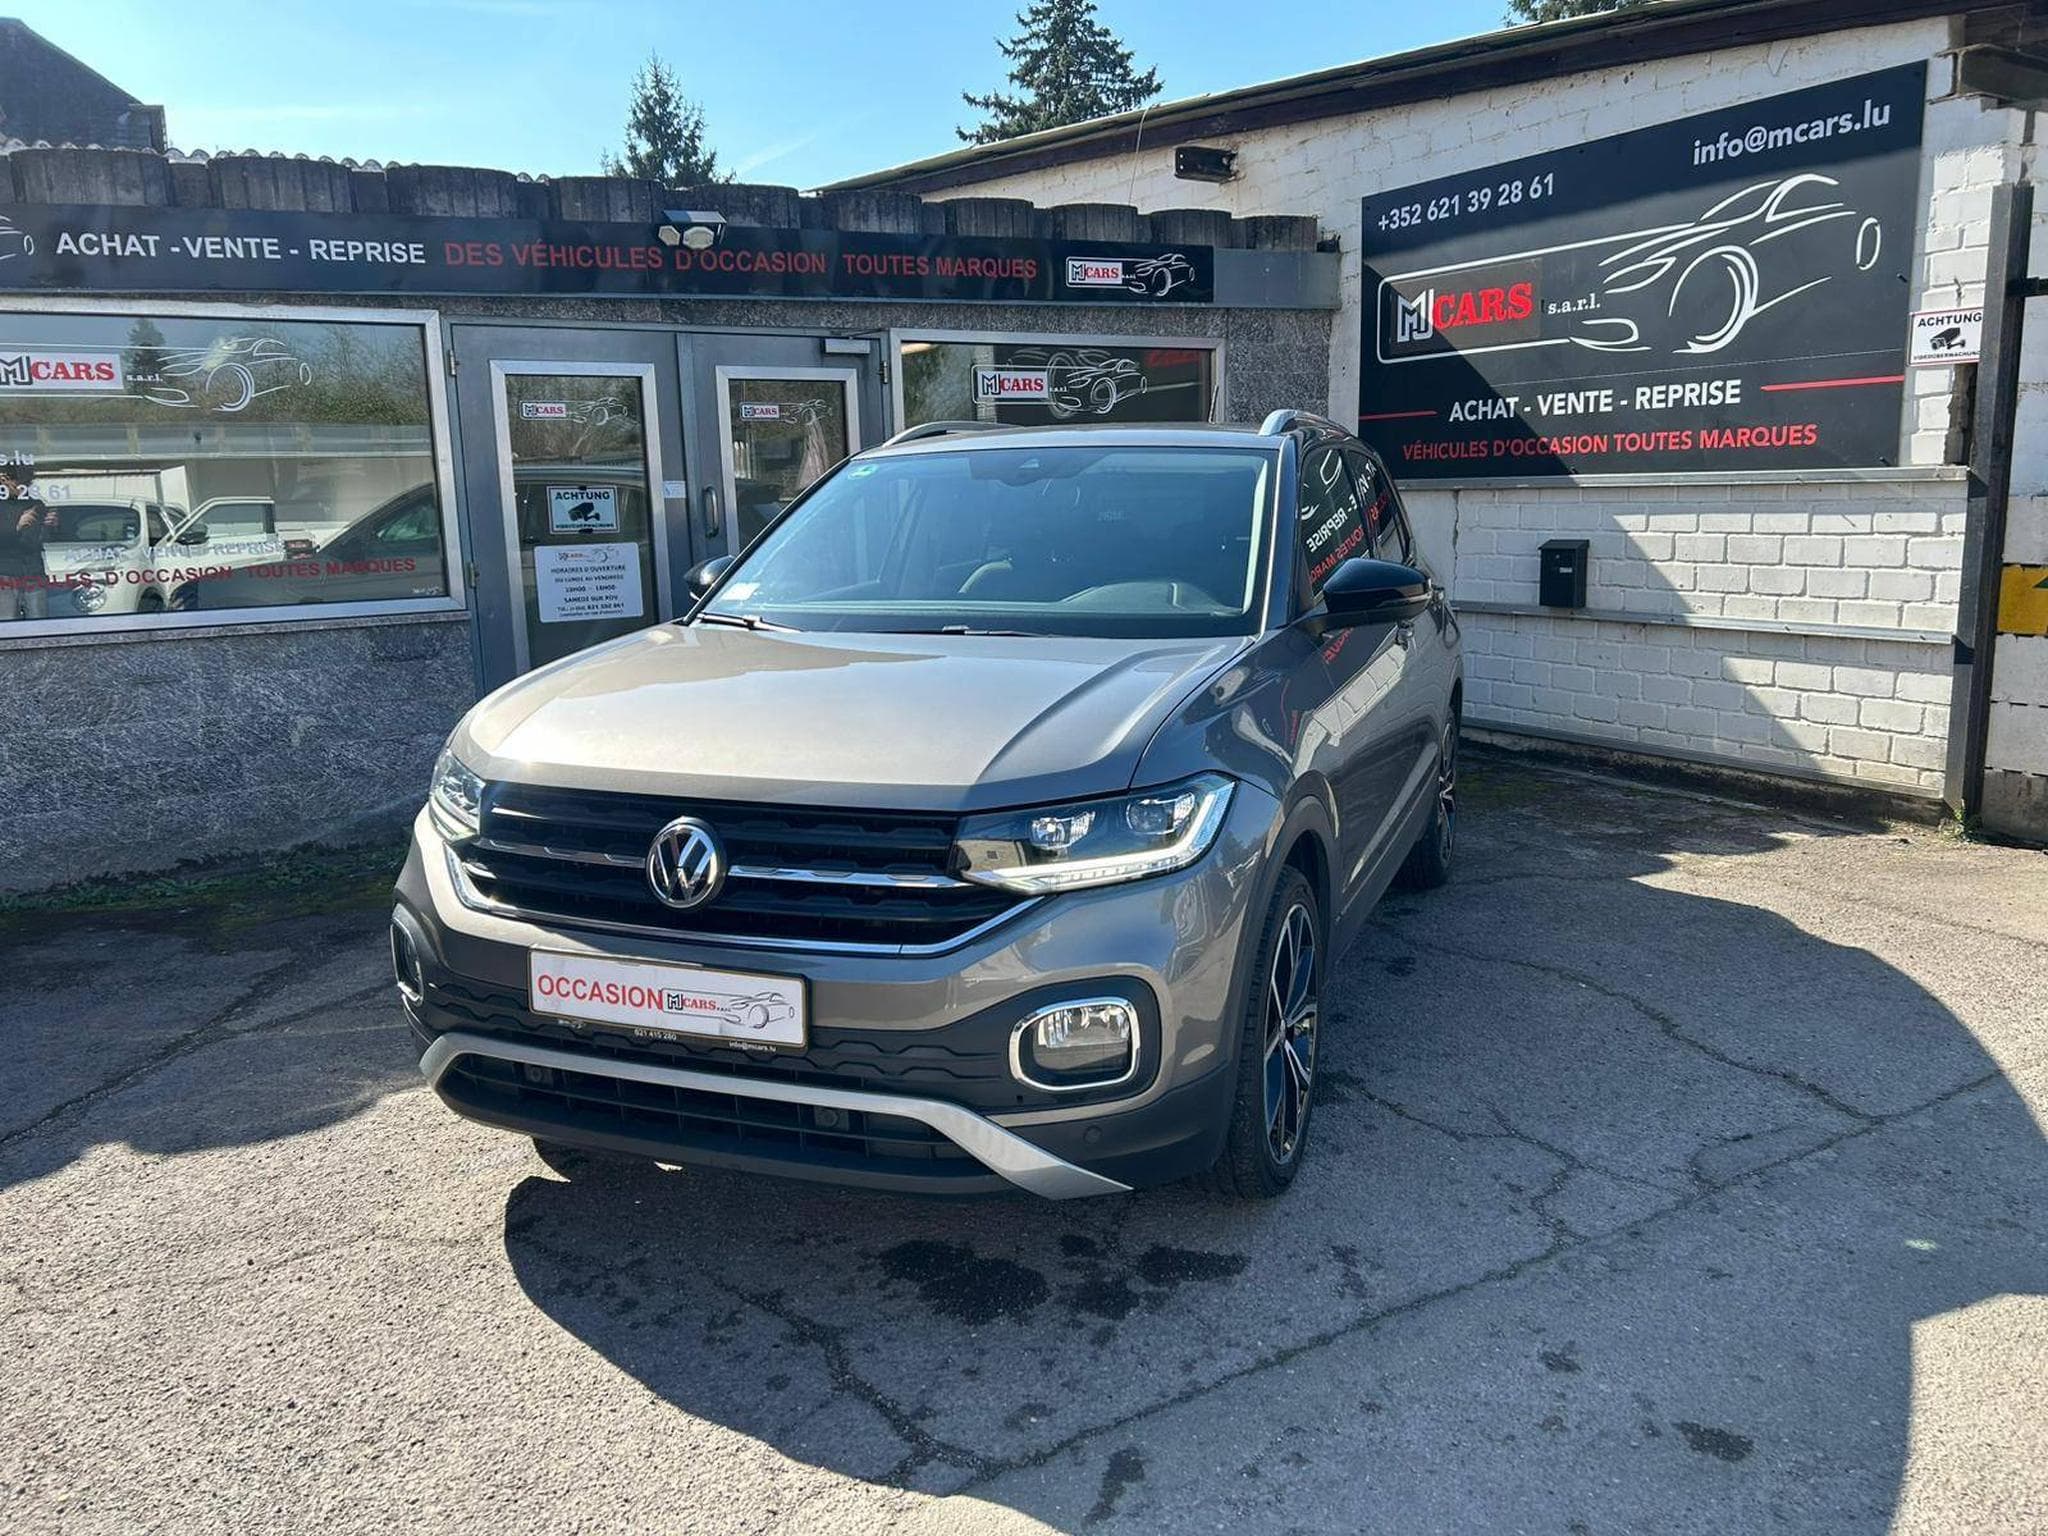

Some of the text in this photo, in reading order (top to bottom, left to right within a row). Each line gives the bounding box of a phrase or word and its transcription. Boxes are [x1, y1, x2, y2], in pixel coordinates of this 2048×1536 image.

[1694, 99, 1891, 166] info@mcars.lu
[1378, 172, 1554, 231] +352 621 39 28 61
[56, 232, 160, 257] ACHAT
[183, 236, 282, 260] VENTE
[310, 240, 426, 264] REPRISE
[444, 242, 502, 267] DES
[512, 239, 664, 270] VÉHICULES
[675, 249, 827, 273] D'OCCASION
[843, 254, 929, 276] TOUTES
[936, 257, 1037, 281] MARQUES
[1548, 293, 1601, 314] s.a.r.l.
[1918, 312, 1982, 327] ACHTUNG
[1449, 396, 1518, 422] ACHAT
[1537, 389, 1612, 416] VENTE
[1635, 379, 1741, 410] REPRISE
[1403, 424, 1818, 460] VÉHICULES D'OCCASION TOUTES MARQUES
[555, 491, 610, 500] ACHTUNG
[106, 565, 232, 586] D'OCCASION
[247, 563, 320, 579] TOUTES
[326, 558, 416, 575] MARQUES
[537, 974, 664, 1010] OCCASION
